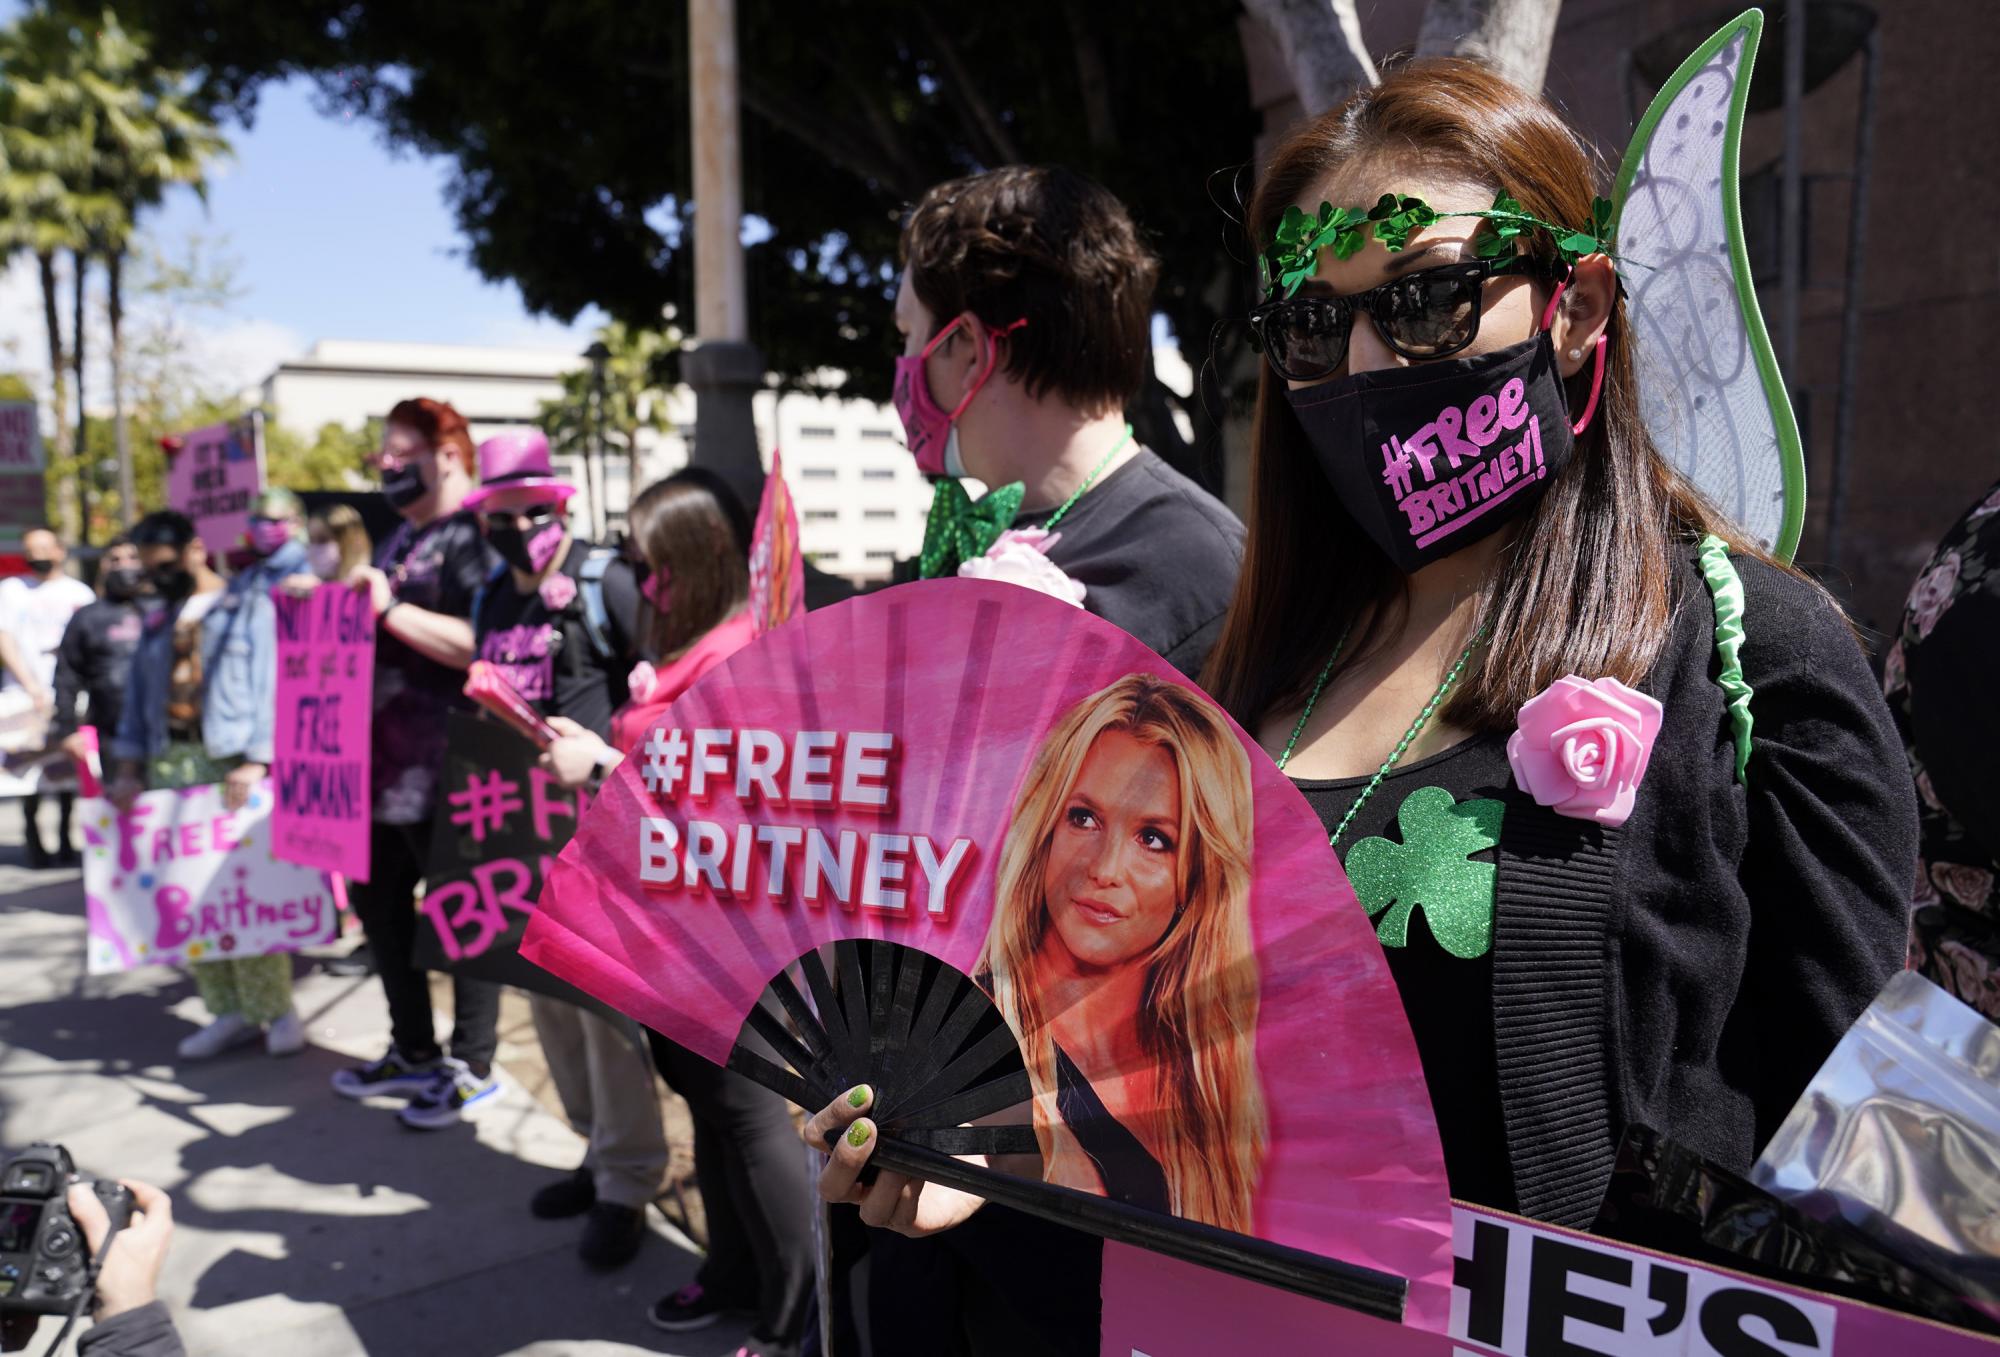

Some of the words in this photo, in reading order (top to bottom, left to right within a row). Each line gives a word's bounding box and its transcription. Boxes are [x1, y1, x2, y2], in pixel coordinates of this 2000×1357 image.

[1398, 414, 1547, 536] BRITNEY!
[319, 588, 336, 642] A
[294, 695, 343, 756] FREE
[278, 759, 362, 820] WOMAN!
[642, 727, 896, 809] #FREE
[116, 805, 238, 873] FREE
[639, 816, 975, 918] BRITNEY
